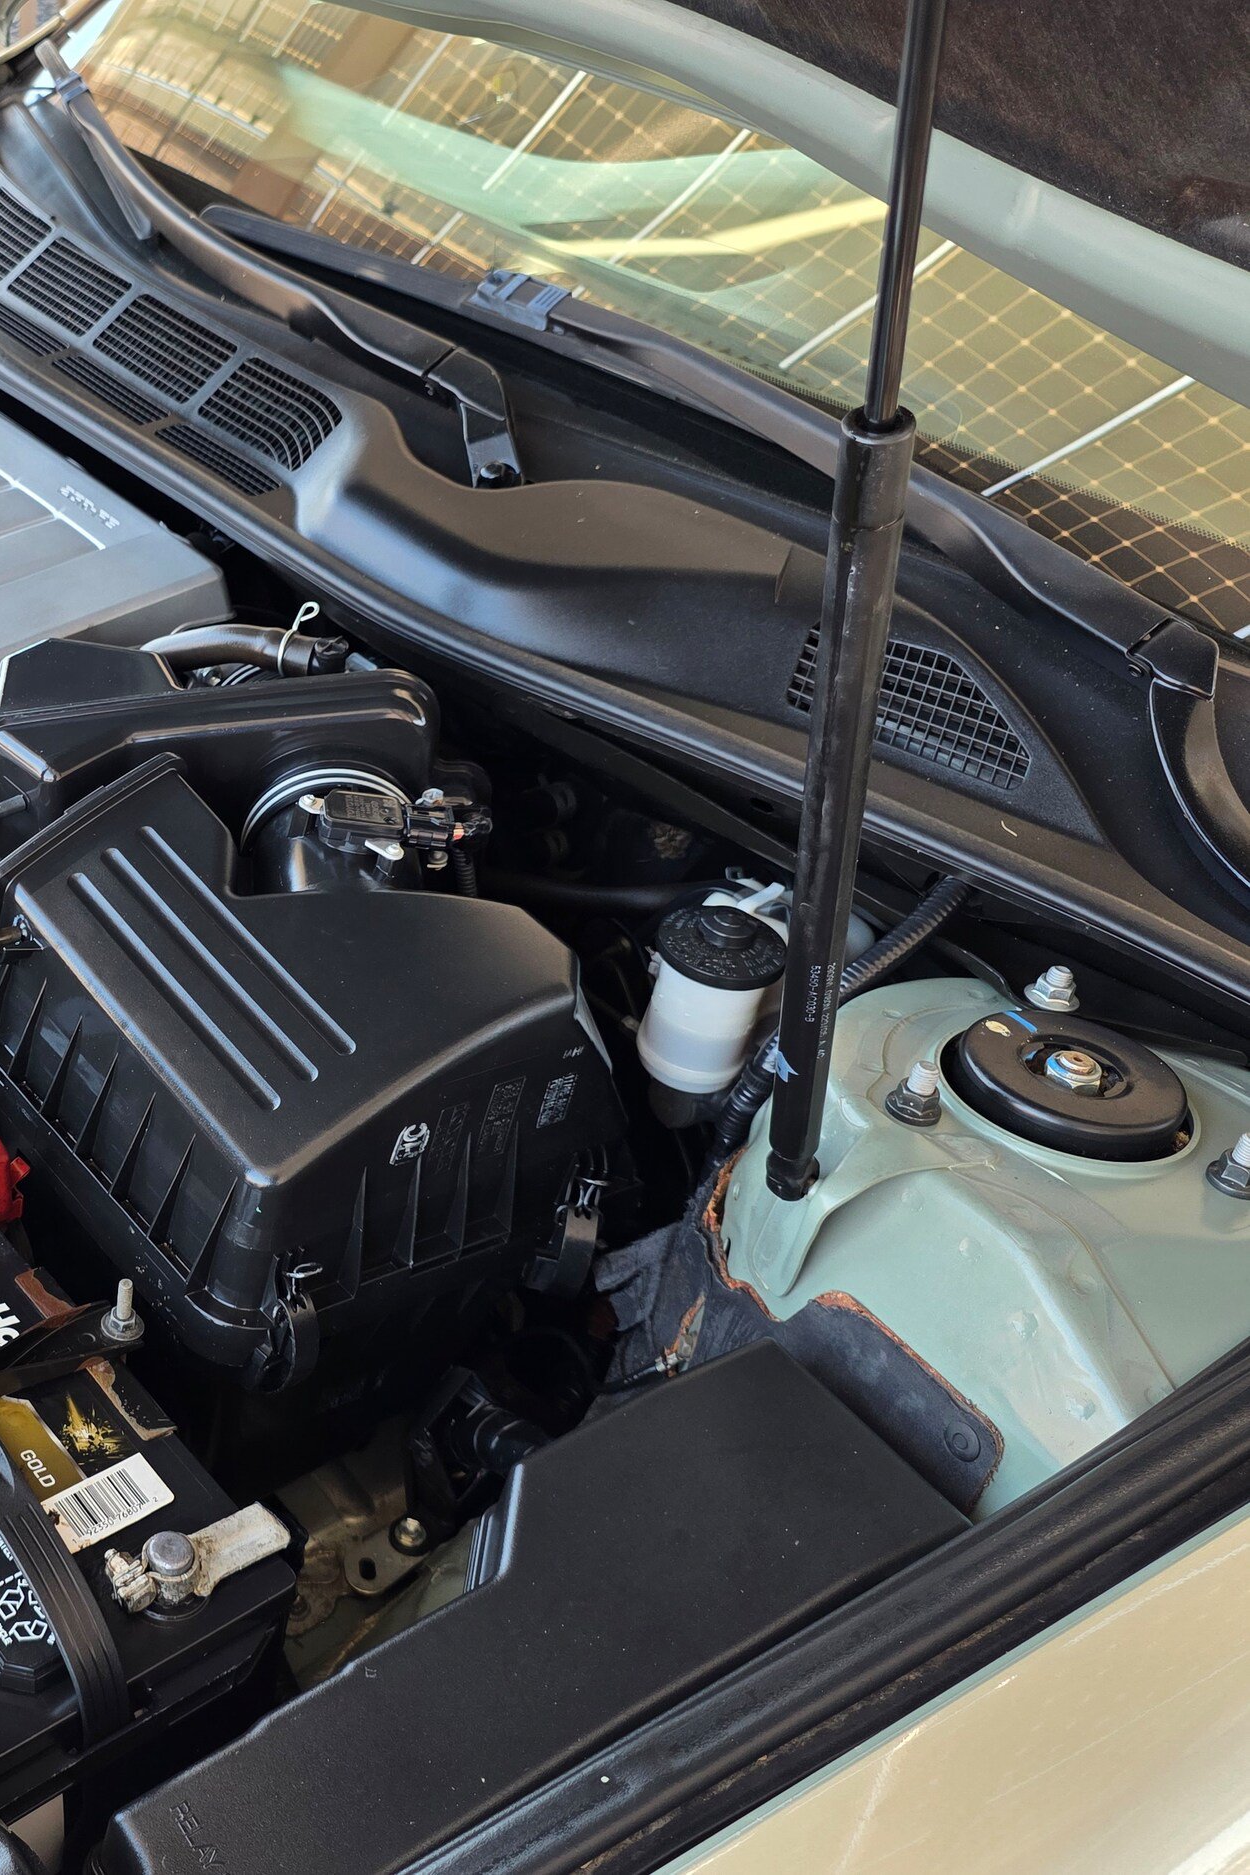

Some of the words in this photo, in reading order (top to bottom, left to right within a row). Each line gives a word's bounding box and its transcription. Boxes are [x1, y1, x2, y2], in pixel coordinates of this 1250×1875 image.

[21, 1450, 55, 1487] GOLD
[150, 1494, 160, 1503] 2
[169, 1799, 227, 1872] RELAY
